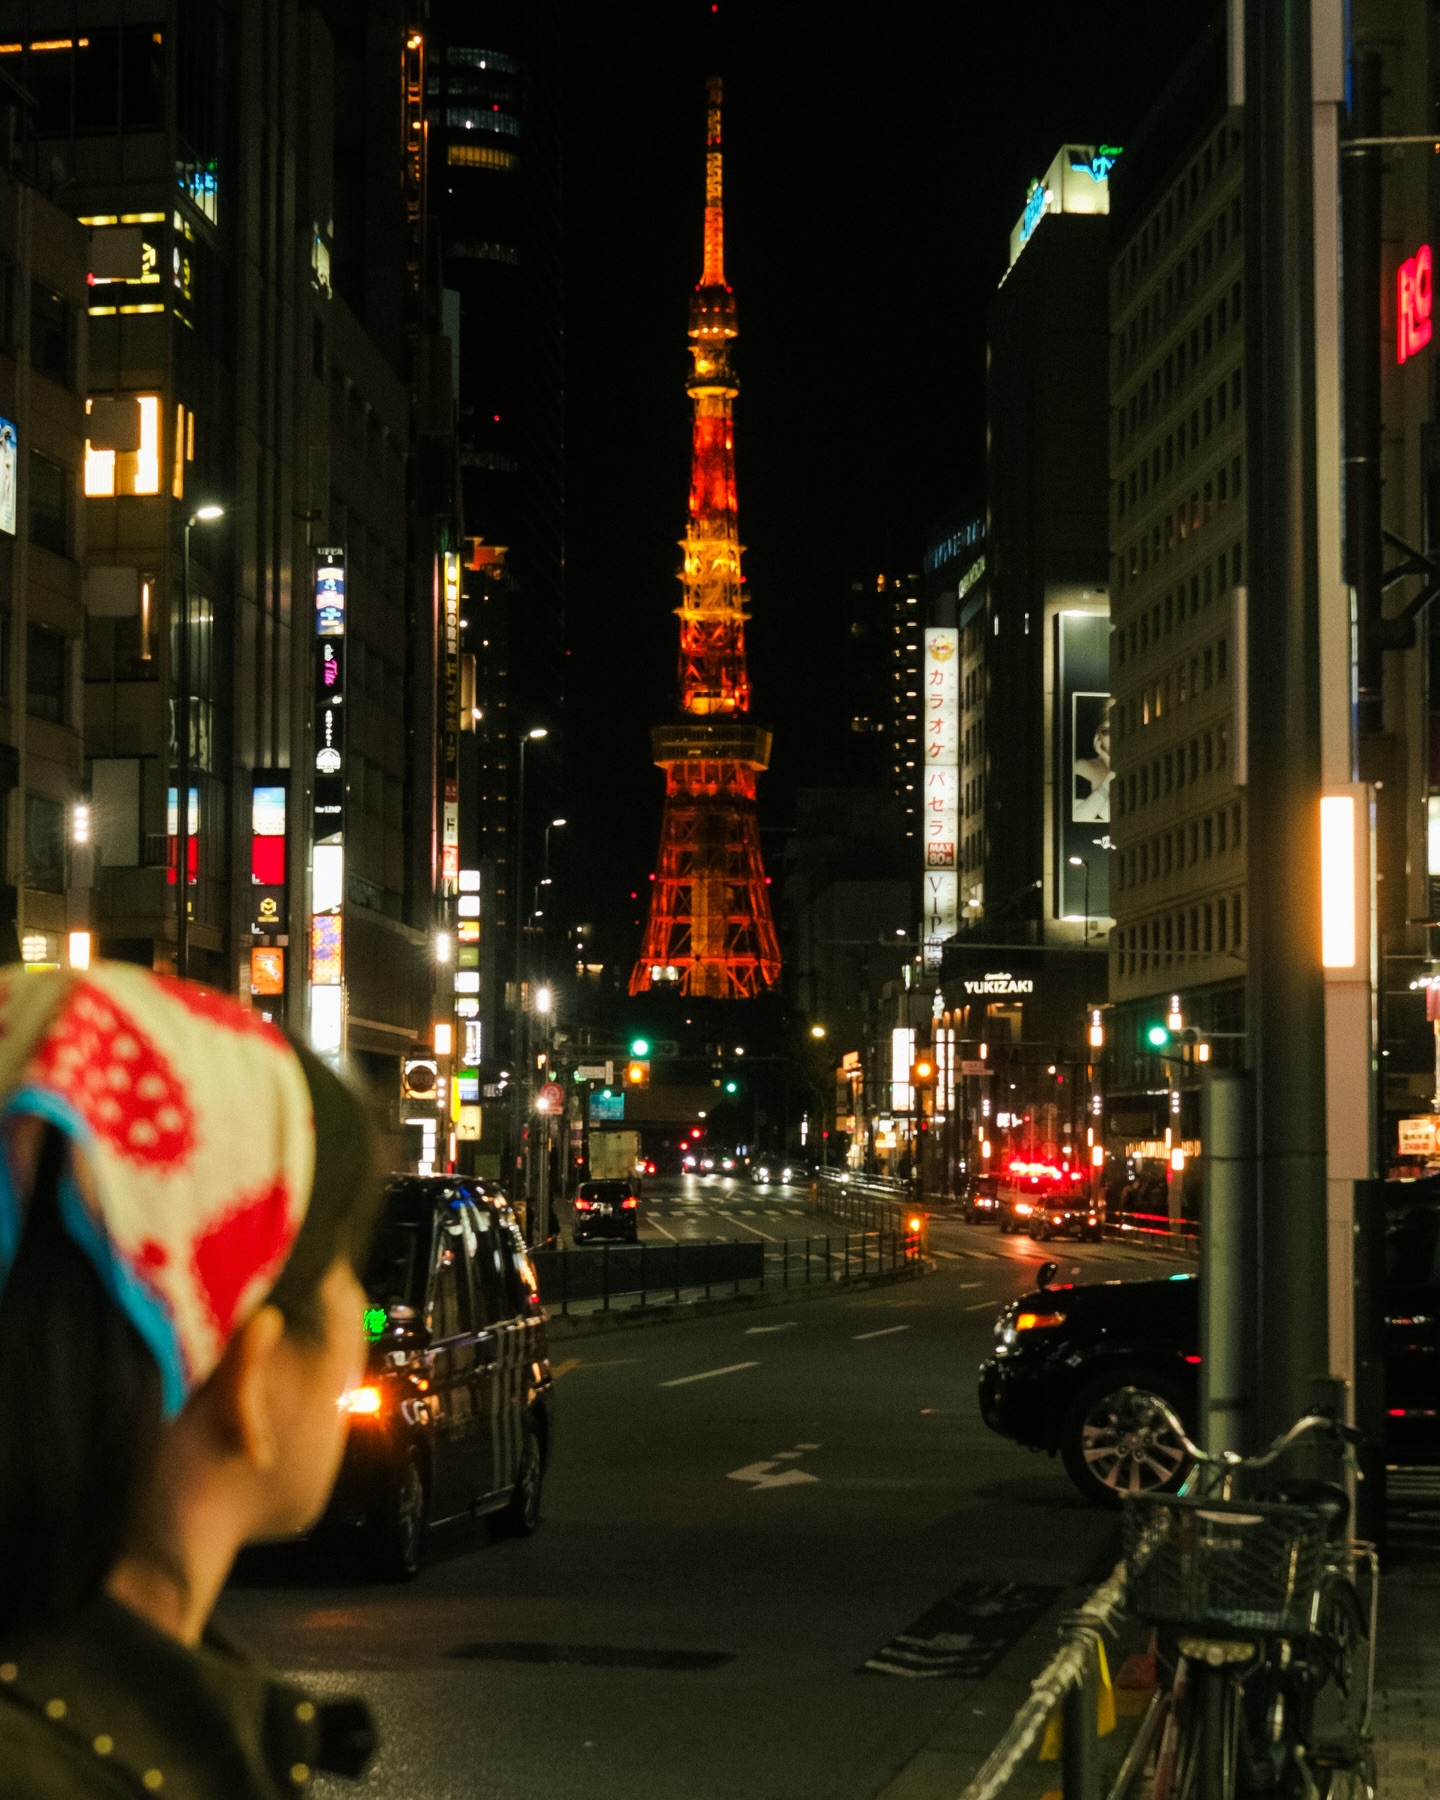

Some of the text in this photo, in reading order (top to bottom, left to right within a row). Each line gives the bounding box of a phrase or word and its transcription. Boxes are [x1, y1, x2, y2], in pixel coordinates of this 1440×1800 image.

[928, 669, 946, 836] カラオケ パセラ
[929, 843, 953, 853] MAX
[964, 980, 1033, 994] YUKIZAKI
